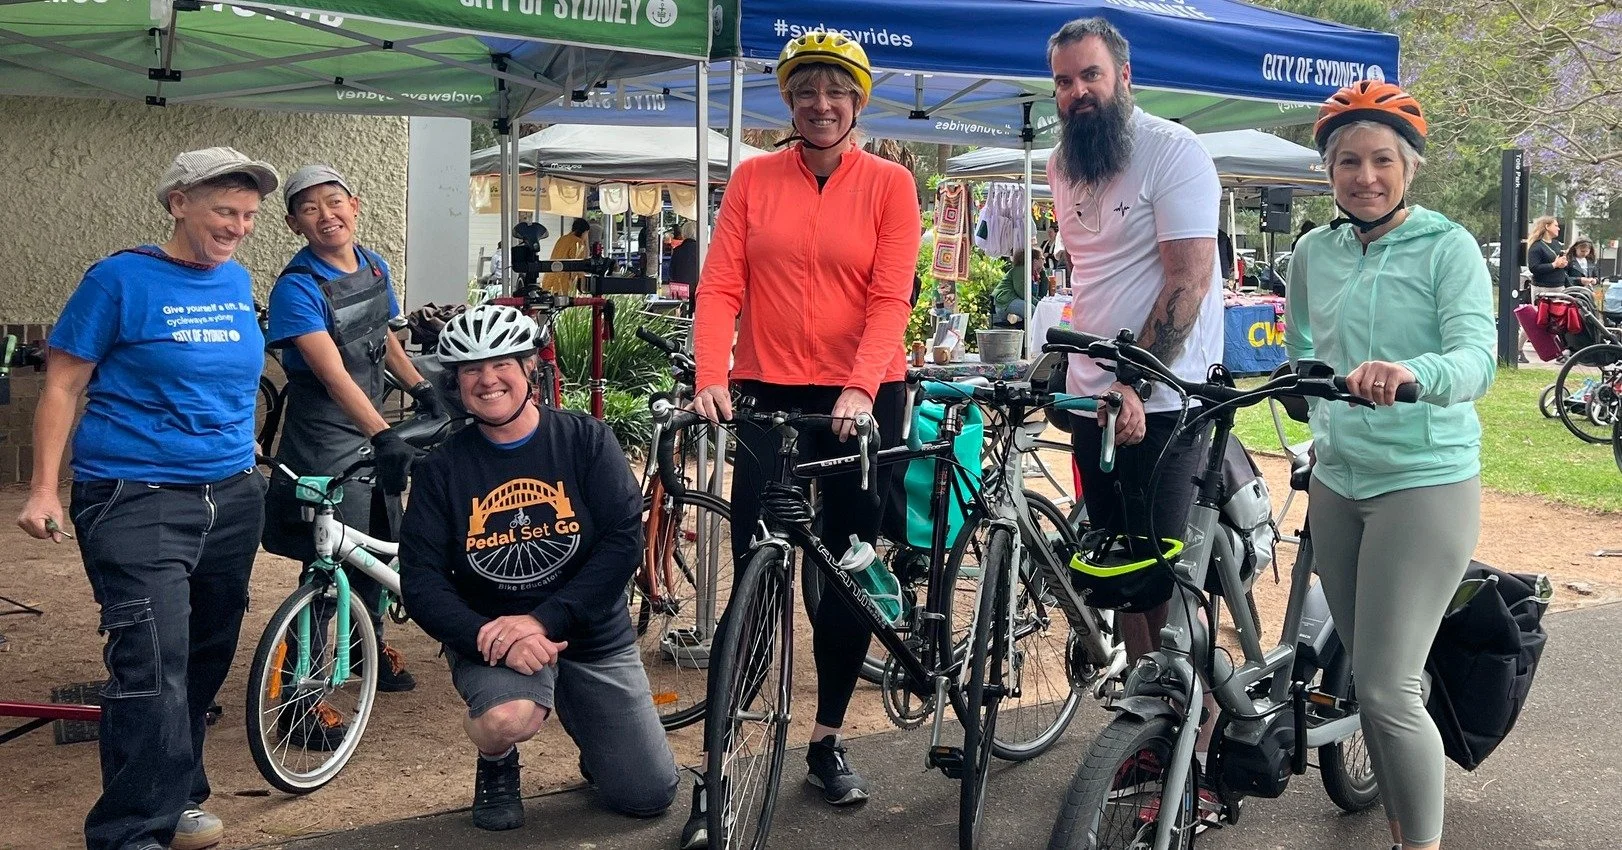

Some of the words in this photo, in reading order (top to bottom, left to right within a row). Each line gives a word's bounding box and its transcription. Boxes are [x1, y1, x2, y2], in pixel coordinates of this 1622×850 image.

[1262, 53, 1294, 82] CITY
[1295, 56, 1313, 84] OF
[1314, 59, 1365, 88] SYDNEY
[162, 306, 184, 315] Give
[186, 303, 217, 314] yourself
[171, 329, 192, 342] CITY
[192, 329, 203, 342] OF
[202, 329, 229, 342] SYDNEY
[1248, 321, 1286, 347] CW
[466, 528, 516, 552] Pedal
[521, 522, 551, 540] Set
[554, 520, 580, 534] Go
[498, 583, 518, 592] Bike
[520, 570, 563, 591] Educators
